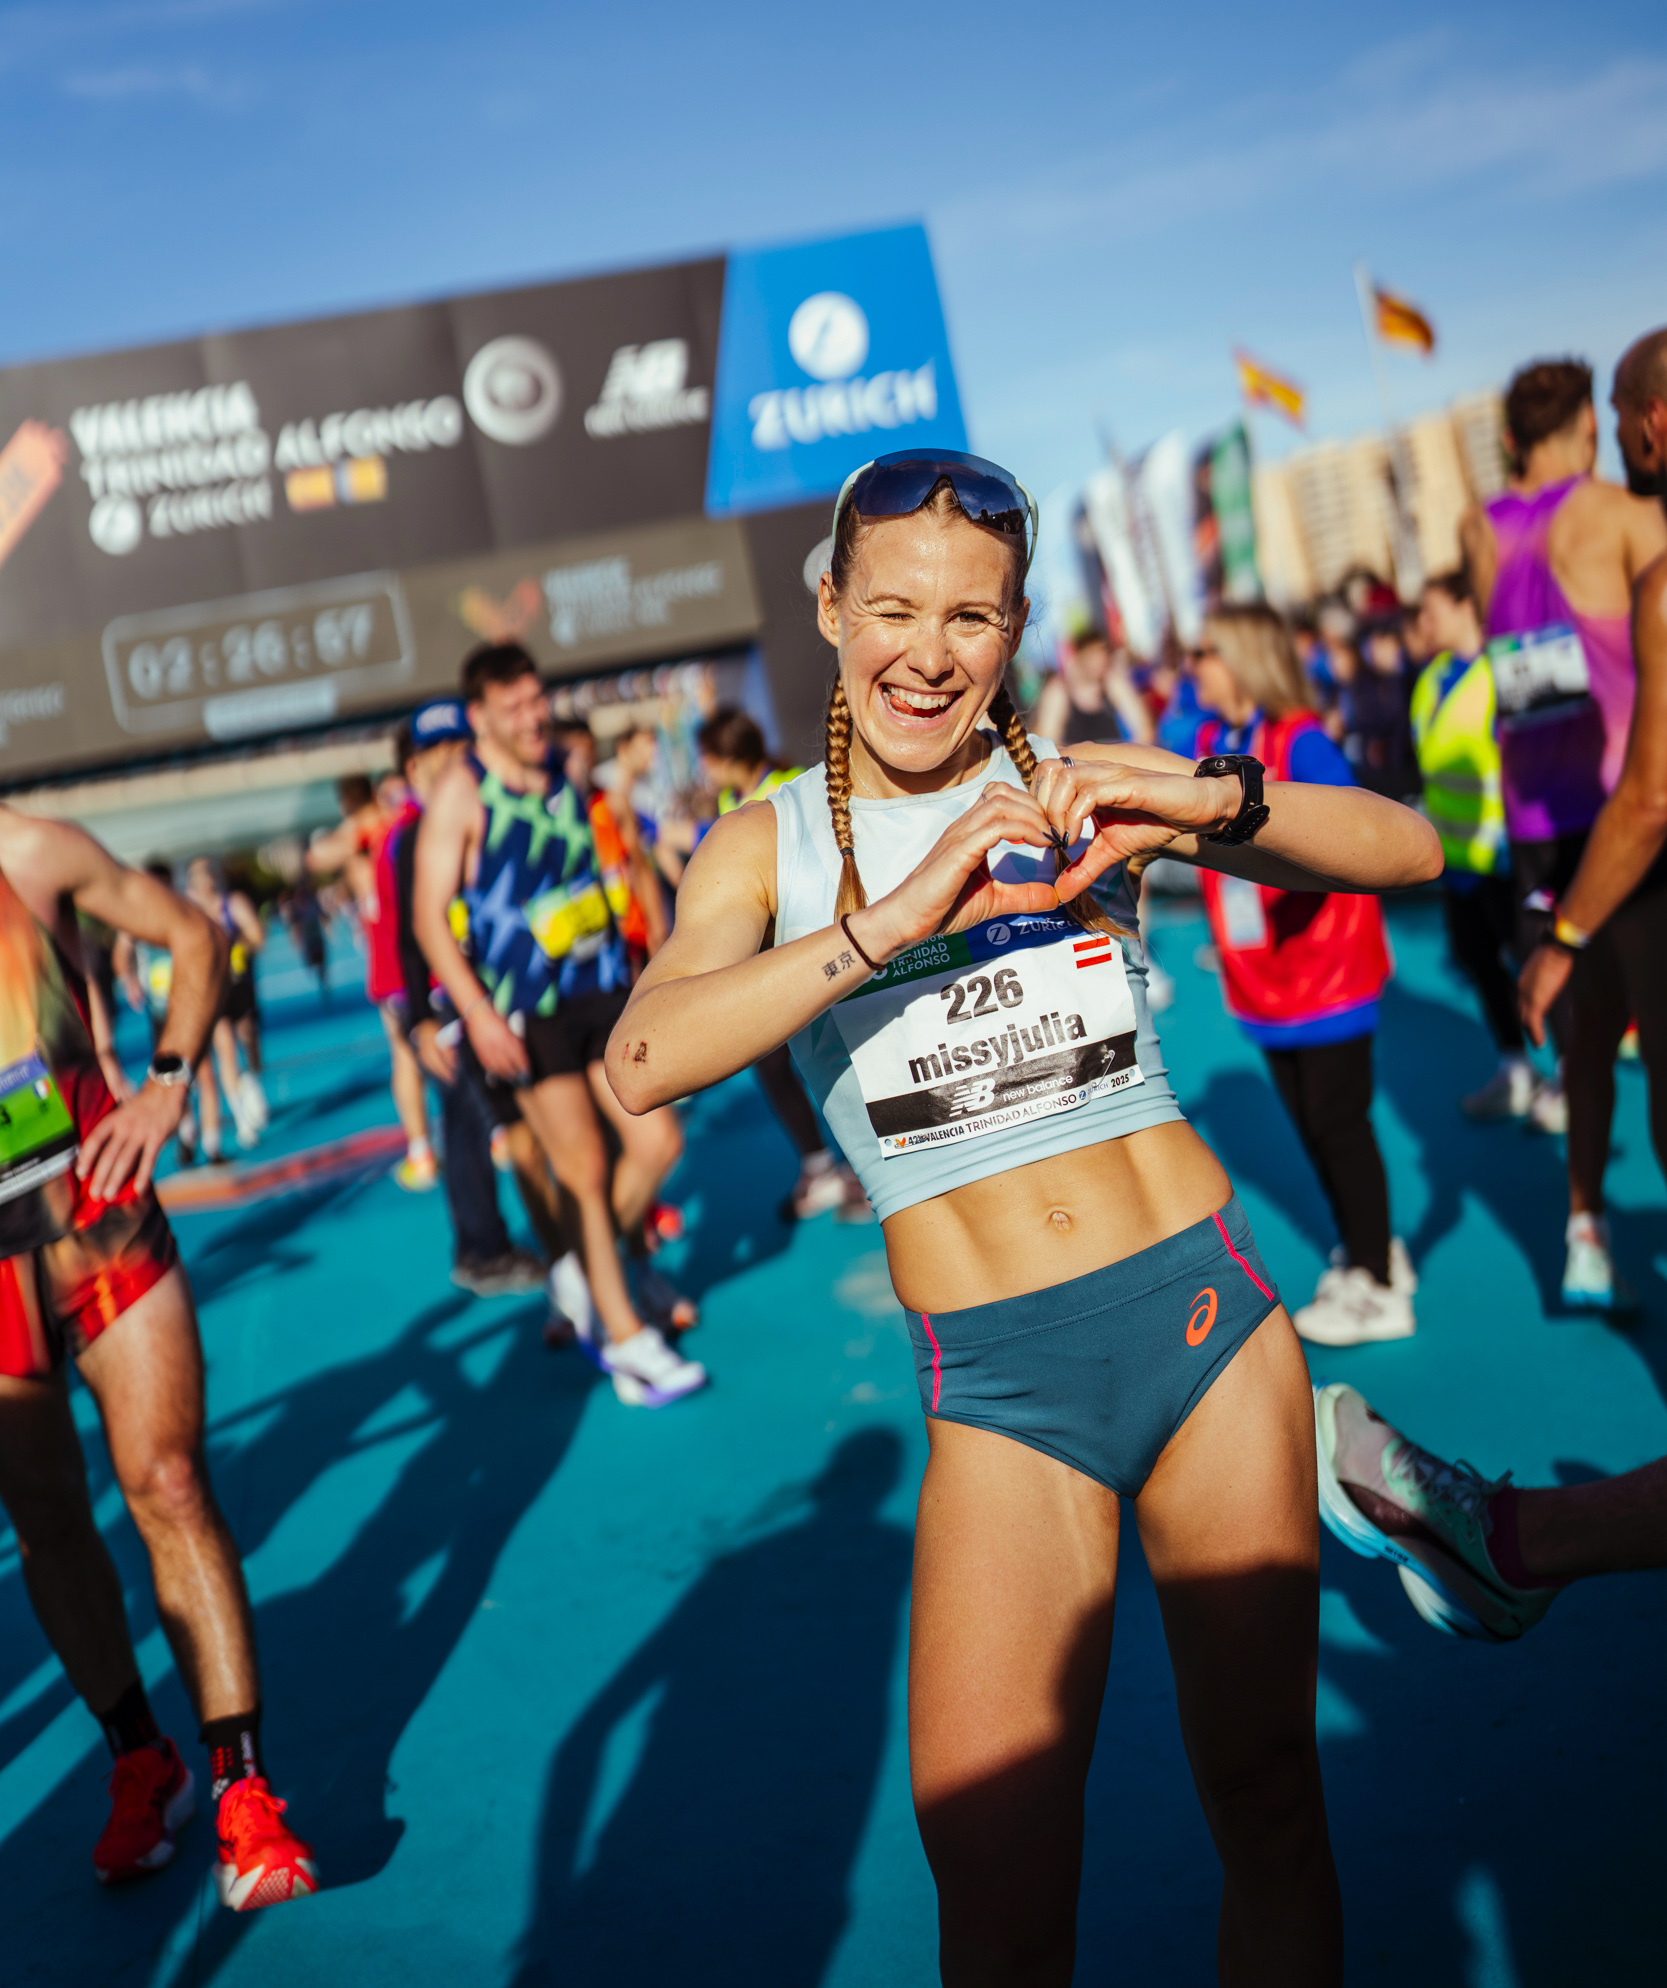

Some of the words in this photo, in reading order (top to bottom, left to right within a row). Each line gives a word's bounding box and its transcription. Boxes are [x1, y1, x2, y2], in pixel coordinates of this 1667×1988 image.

[71, 382, 258, 454] VALENCIA
[750, 367, 937, 449] ZURICH
[82, 429, 270, 498] TRINIDAD
[276, 396, 461, 470] ALFONSO
[150, 479, 272, 536] ZURICH
[822, 950, 855, 981] 東京
[893, 953, 950, 978] ALFONSO
[940, 968, 1024, 1025] 226
[908, 1012, 1087, 1084] missyjulia
[926, 1126, 964, 1142] VALENCIA
[965, 1110, 1021, 1133] TRINIDAD
[1022, 1094, 1077, 1118] ALFONSO
[1110, 1074, 1130, 1088] 2025
[1002, 1089, 1025, 1102] new
[1027, 1075, 1074, 1095] balance
